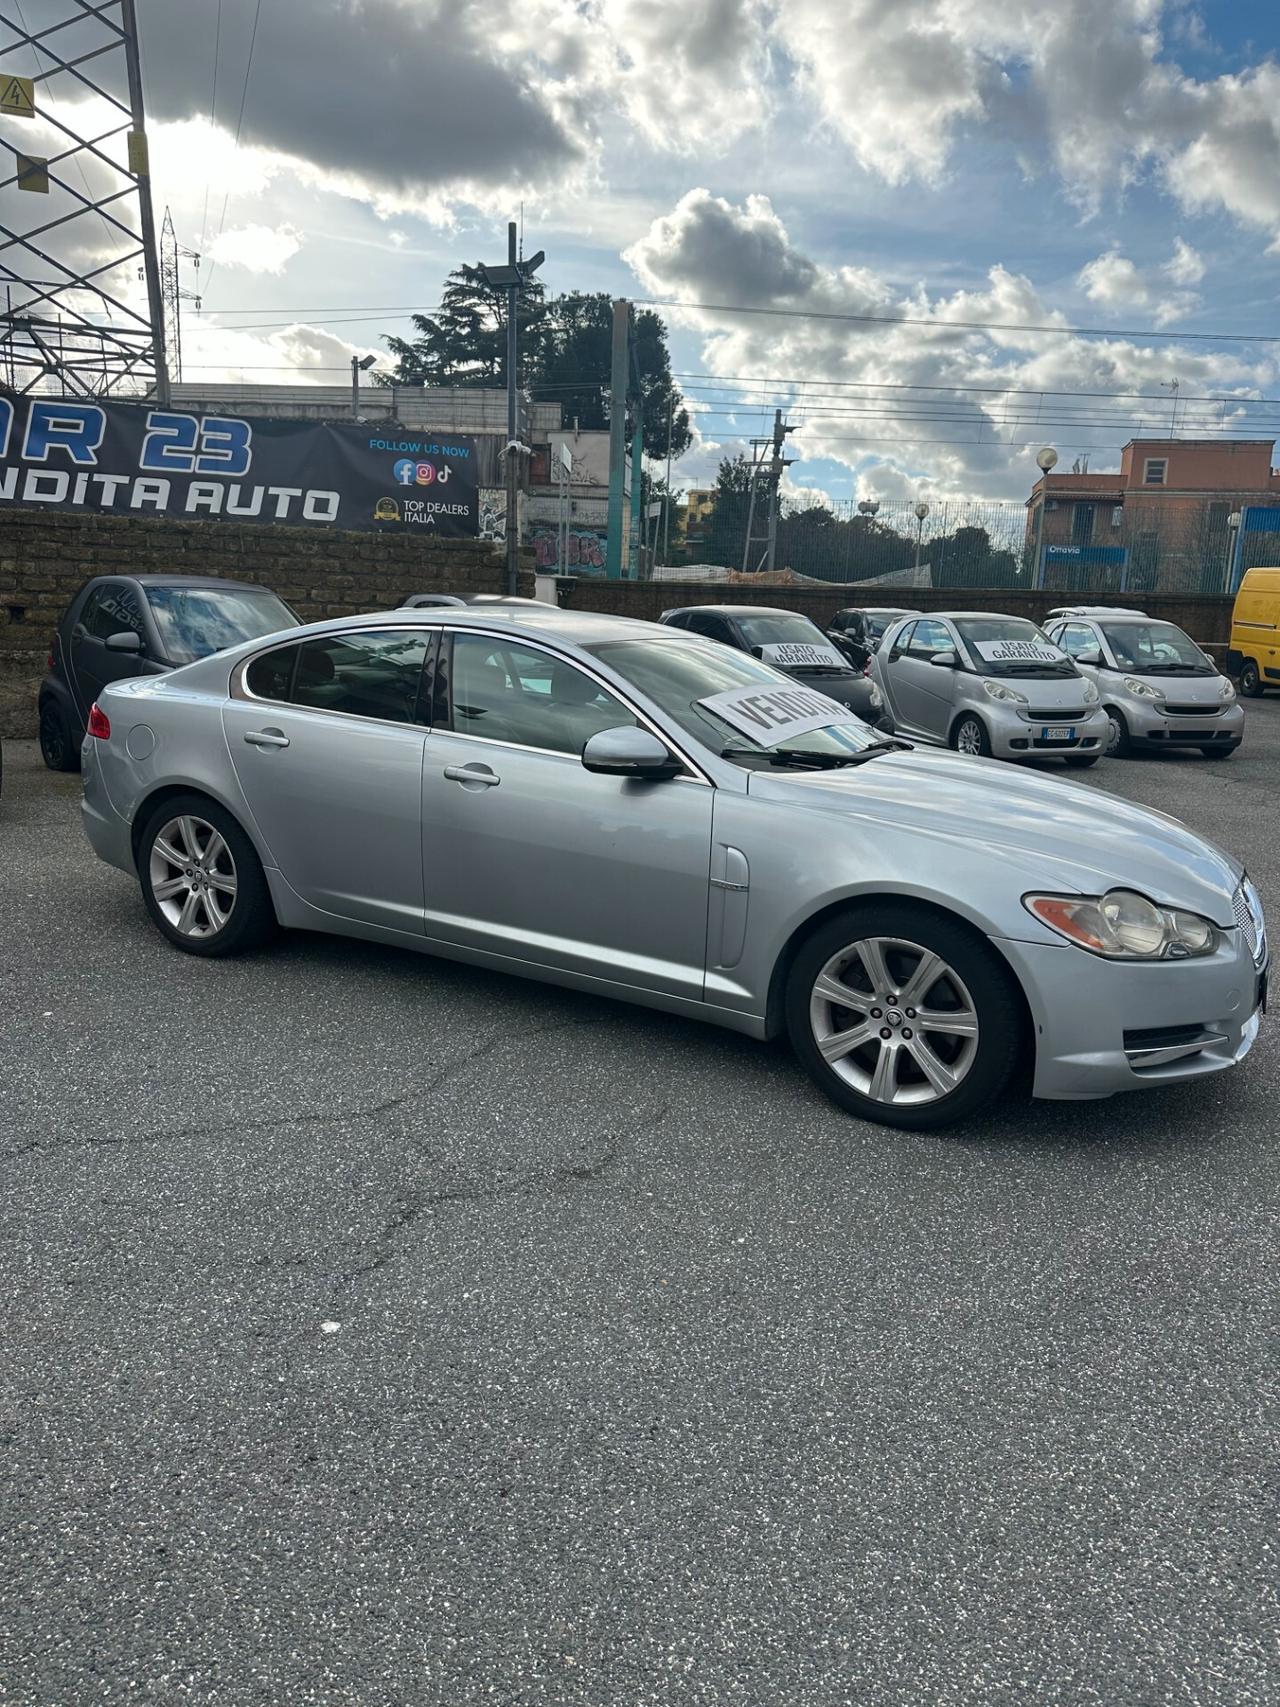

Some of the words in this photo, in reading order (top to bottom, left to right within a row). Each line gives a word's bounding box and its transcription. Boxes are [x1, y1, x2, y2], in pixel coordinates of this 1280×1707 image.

[0, 396, 107, 465] R
[139, 411, 252, 477] 23
[369, 439, 420, 453] FOLLOW
[424, 444, 439, 455] US
[442, 446, 470, 458] NOW
[185, 480, 341, 522] AUTO
[404, 500, 425, 512] TOP
[427, 502, 470, 516] DEALERS
[404, 511, 436, 524] ITALIA
[776, 644, 816, 655] USATO
[1000, 641, 1038, 652] USATO
[992, 650, 1056, 661] GARANTITO
[727, 690, 849, 730] VENDITA
